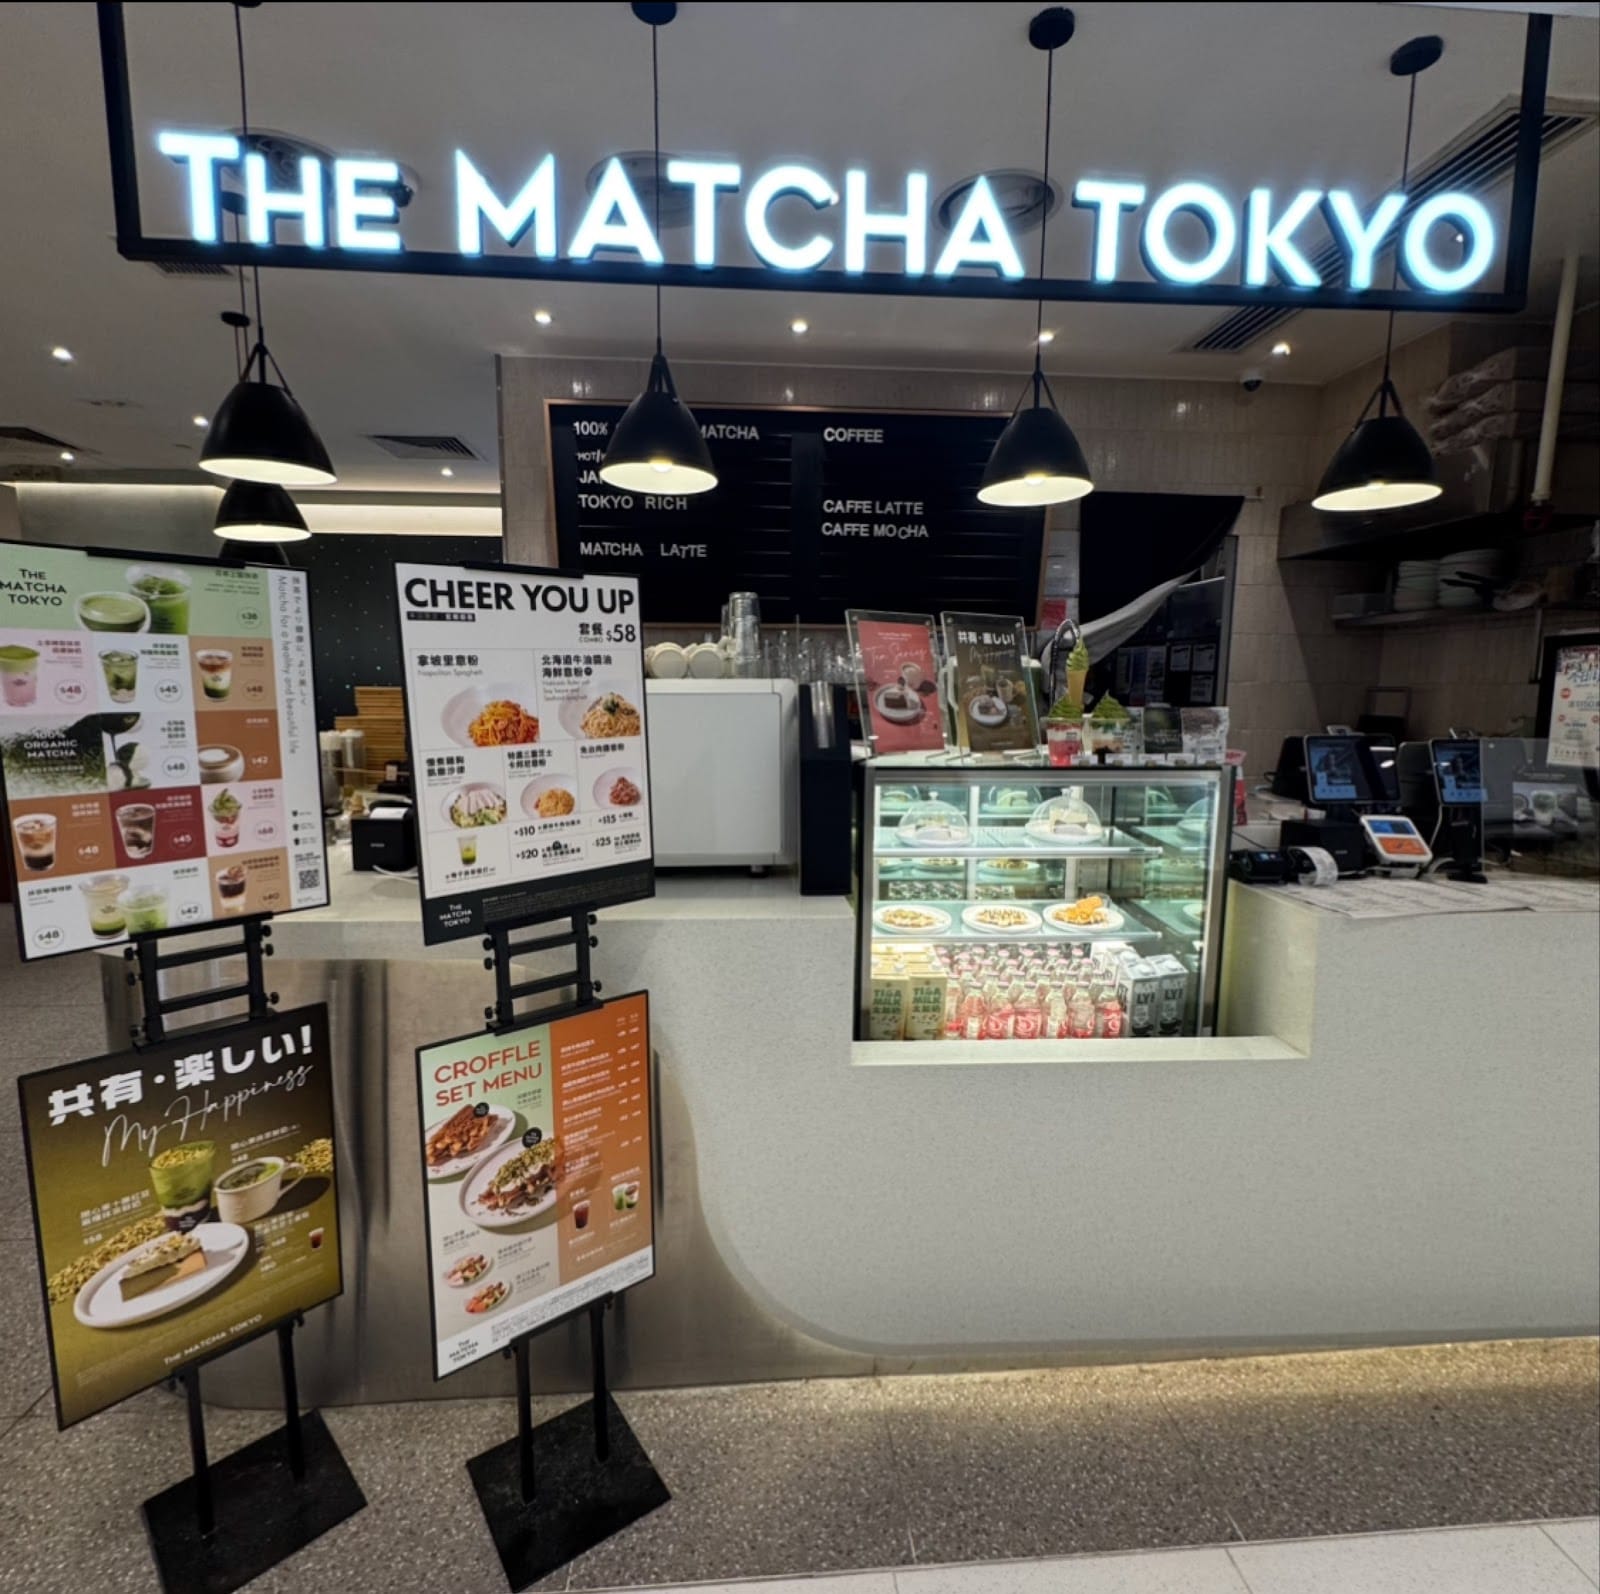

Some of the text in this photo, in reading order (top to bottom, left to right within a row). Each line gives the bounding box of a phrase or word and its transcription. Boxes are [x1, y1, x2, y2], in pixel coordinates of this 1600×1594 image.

[155, 130, 1496, 294] THE MATCHA TOKYO
[573, 421, 609, 436] 100%
[823, 427, 884, 443] COFFEE
[578, 494, 688, 510] TOKYO RICH
[823, 499, 924, 515] CAFFE LATTE
[821, 522, 929, 539] CAFFE MOCHA
[579, 541, 707, 559] MATCHA LATTE
[19, 568, 47, 580] THE
[0, 582, 67, 594] MATCHA
[404, 577, 635, 615] CHEER YOU UP
[8, 594, 63, 606] TOKYO
[606, 624, 636, 643] $58
[23, 739, 79, 750] ORGANIC
[27, 749, 77, 758] MATCHA
[443, 917, 471, 928] TOKYO
[434, 1040, 541, 1084] CROFFLE
[435, 1062, 543, 1107] SET MENU
[102, 1063, 314, 1167] My Happiness
[184, 1331, 227, 1356] MATCHA
[229, 1314, 263, 1334] TOKYO
